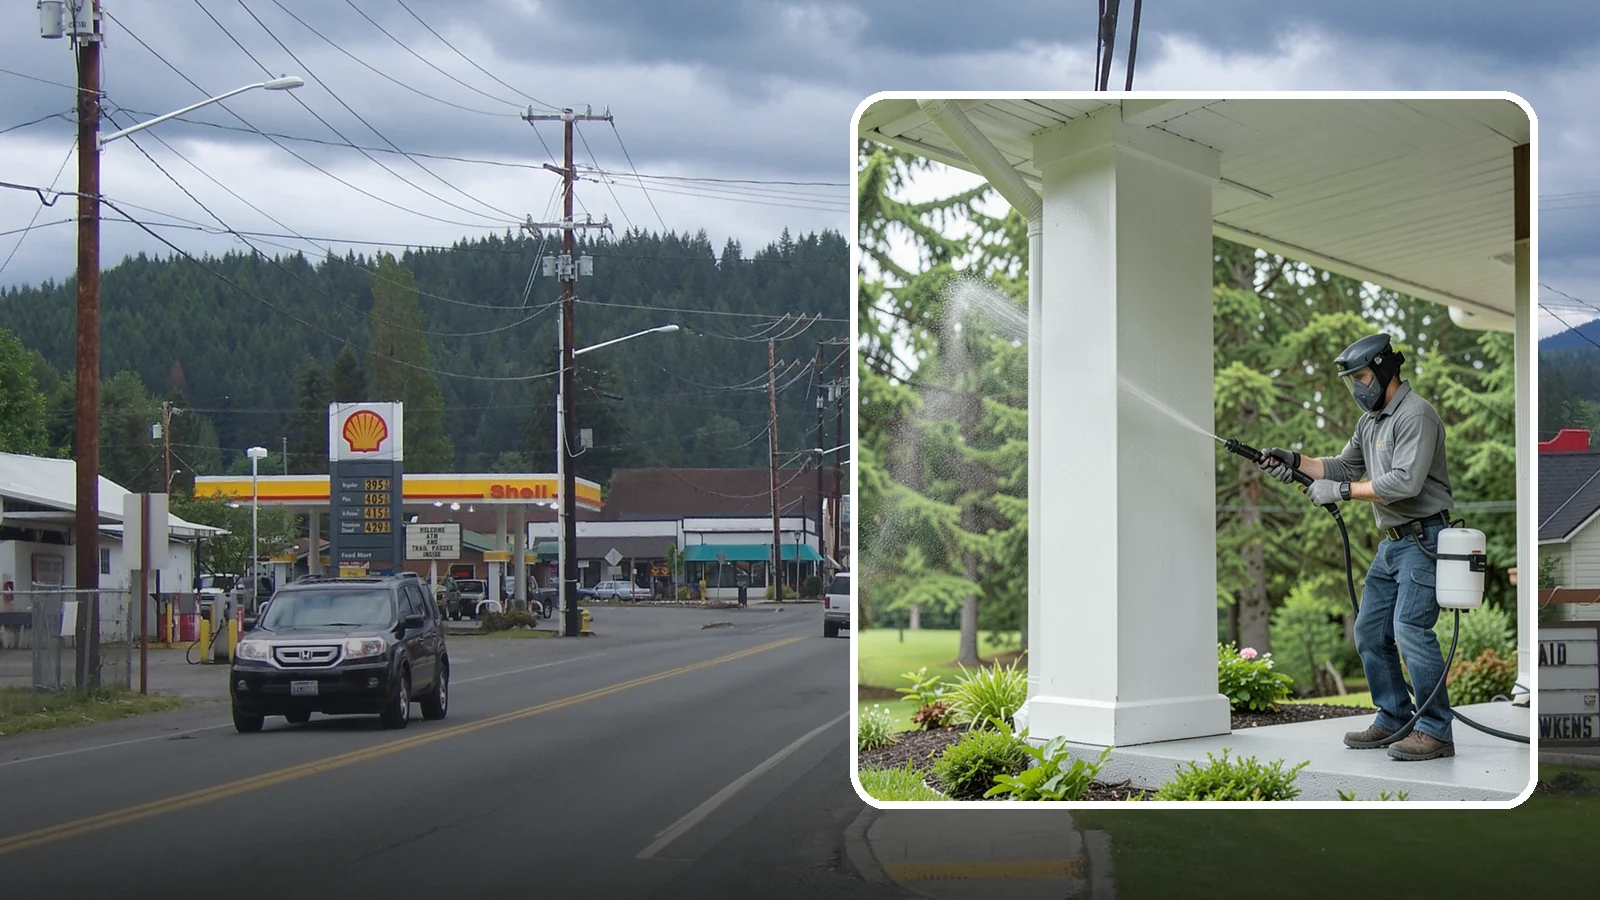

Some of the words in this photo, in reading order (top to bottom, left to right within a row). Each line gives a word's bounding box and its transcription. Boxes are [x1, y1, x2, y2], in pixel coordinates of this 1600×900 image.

[365, 480, 383, 490] 395
[490, 484, 548, 499] Shell
[365, 494, 383, 504] 405
[365, 508, 383, 518] 415
[365, 522, 383, 532] 429
